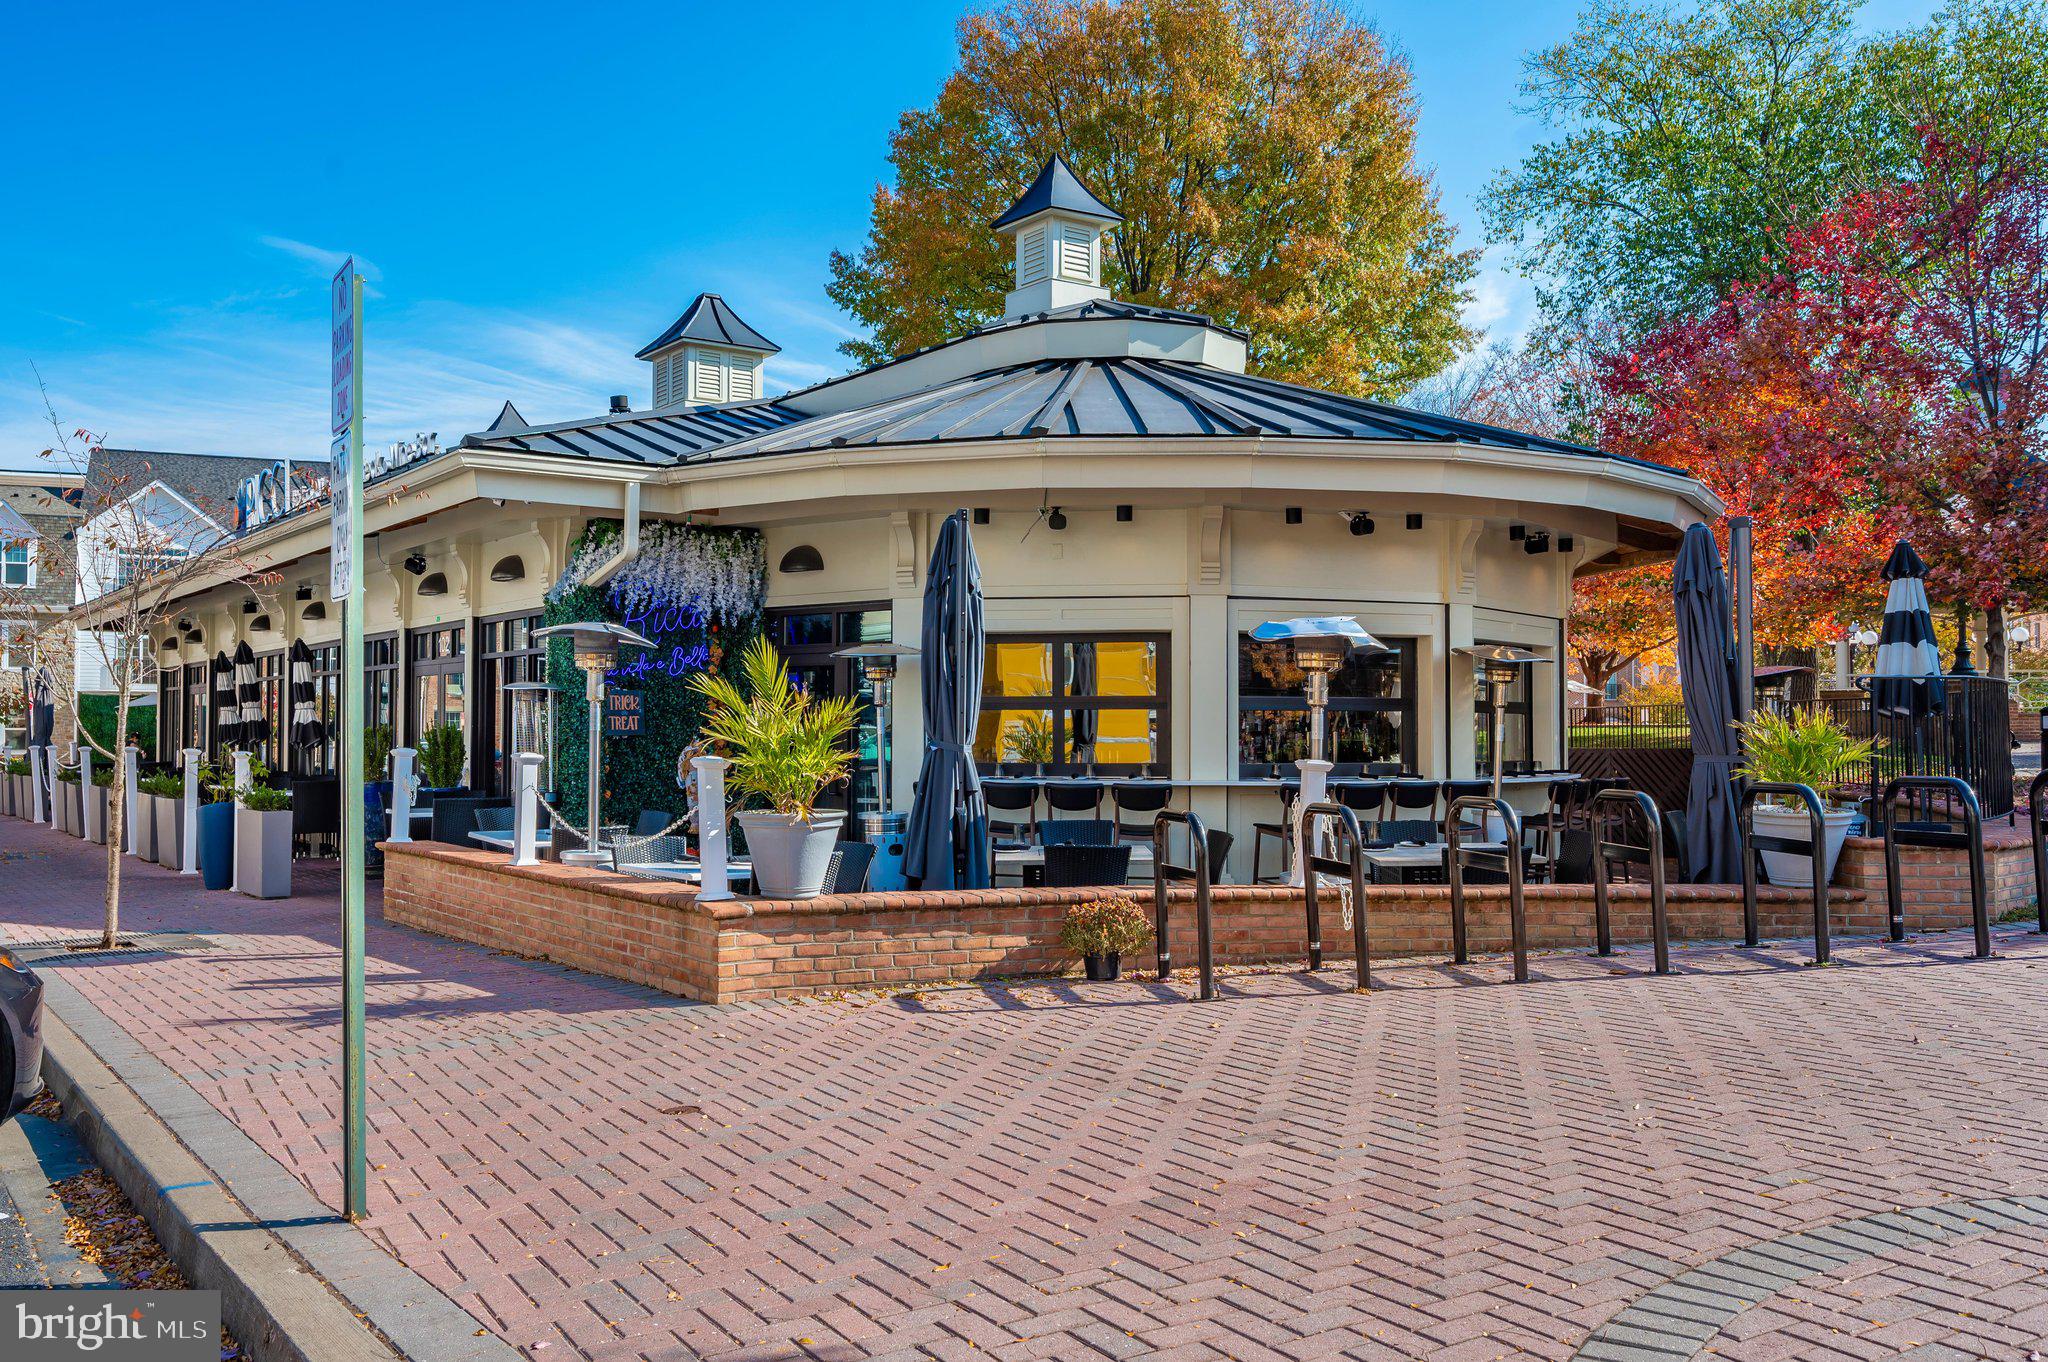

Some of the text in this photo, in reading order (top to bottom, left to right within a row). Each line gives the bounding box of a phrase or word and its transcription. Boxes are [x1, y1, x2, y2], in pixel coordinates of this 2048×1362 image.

[338, 281, 347, 315] NO
[332, 314, 352, 358] PARKING
[333, 350, 352, 388] LOADING
[337, 384, 349, 418] ZONE
[608, 694, 640, 711] TRICK
[608, 715, 640, 730] TREAT
